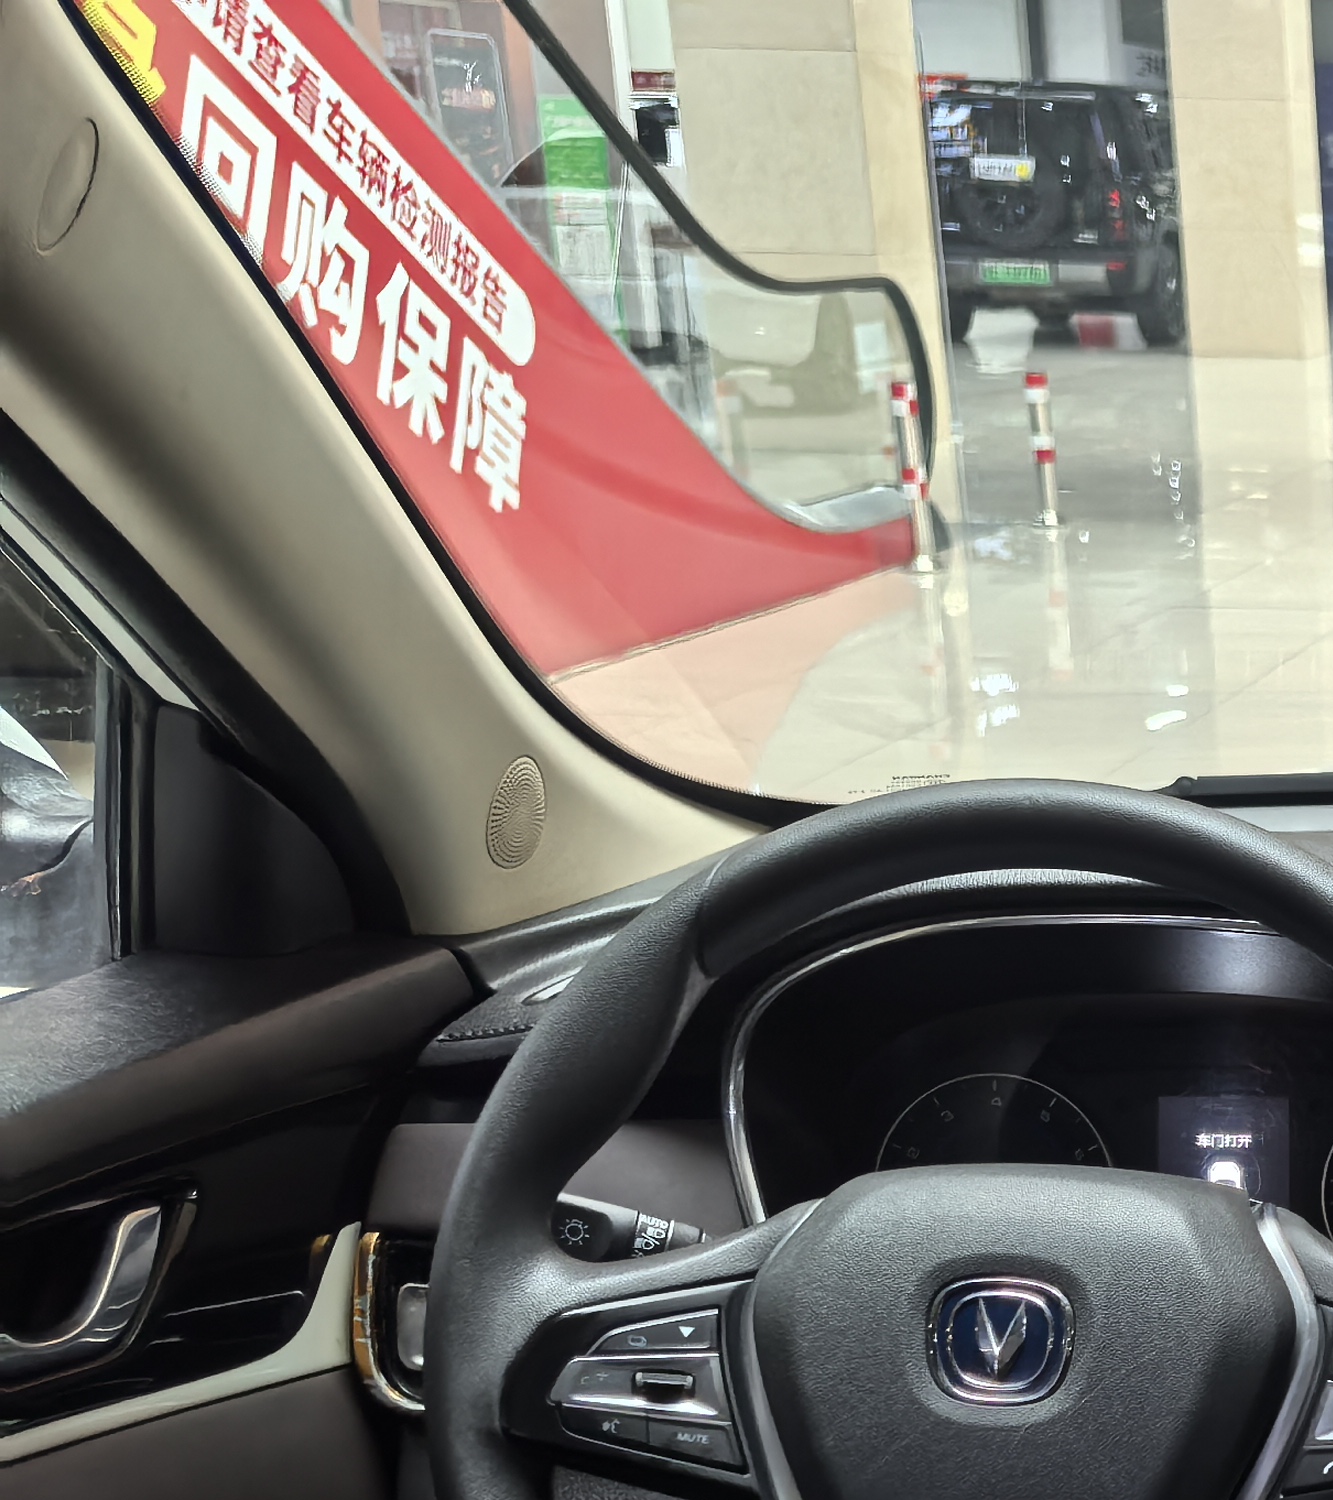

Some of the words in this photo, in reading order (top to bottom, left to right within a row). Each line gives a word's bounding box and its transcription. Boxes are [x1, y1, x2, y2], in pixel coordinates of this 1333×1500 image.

[181, 54, 529, 512] 回购保障
[1194, 1132, 1253, 1150] 车门打开
[677, 1432, 710, 1445] MUTE
